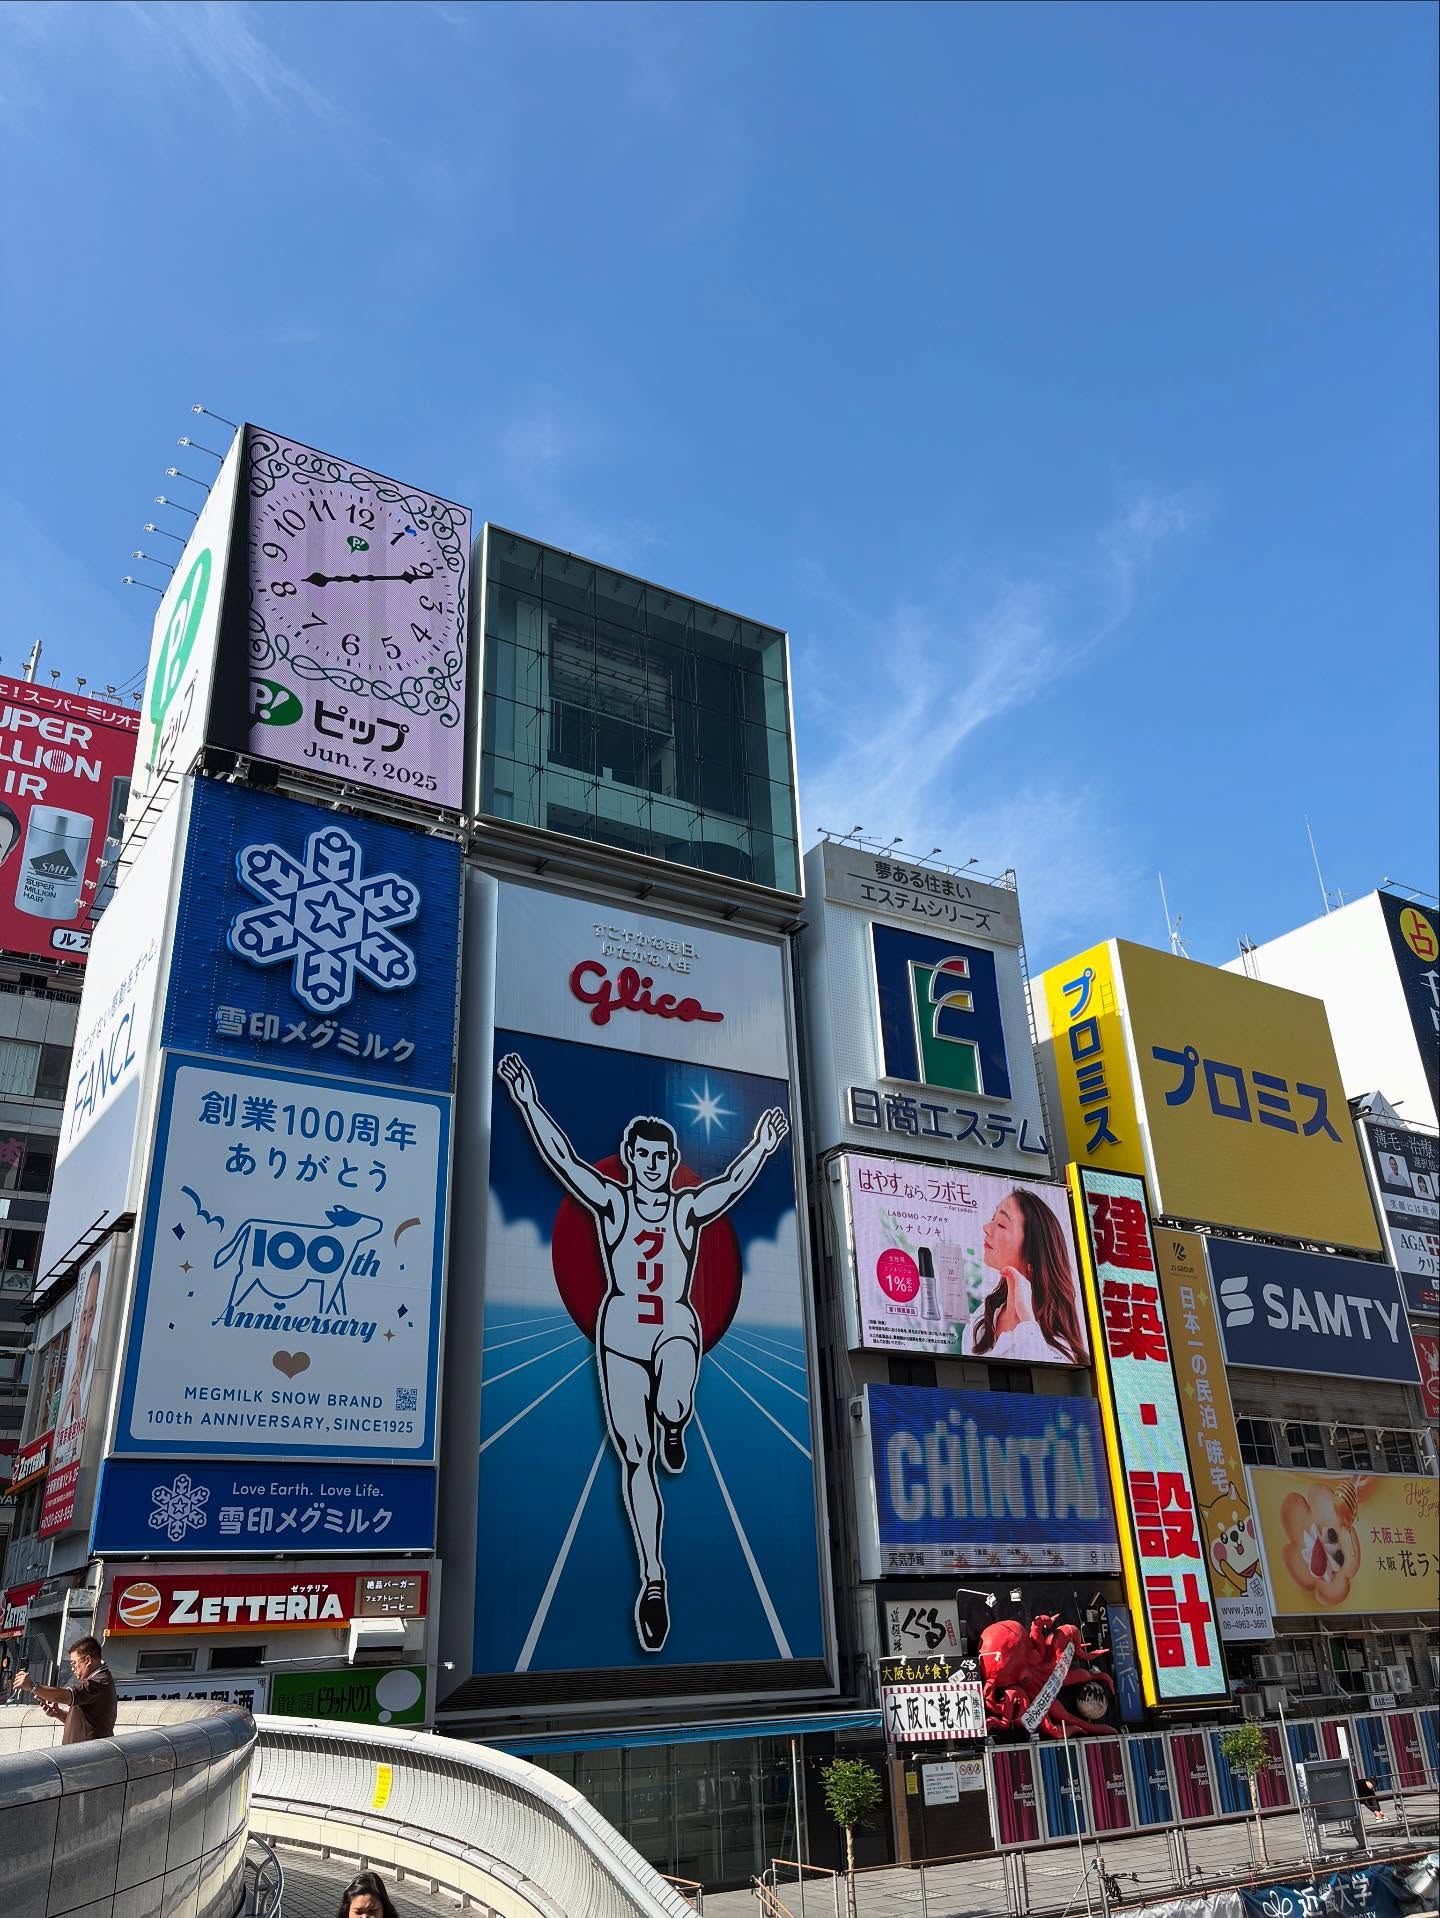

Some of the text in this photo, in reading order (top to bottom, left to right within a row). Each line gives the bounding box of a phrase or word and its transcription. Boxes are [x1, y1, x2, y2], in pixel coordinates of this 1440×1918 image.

[309, 500, 336, 522] 11
[346, 504, 375, 531] 12
[274, 509, 306, 537] 10
[262, 542, 287, 562] 9
[270, 581, 297, 598] 8
[419, 595, 443, 614] 3
[302, 612, 328, 629] 7
[410, 623, 432, 643] 4
[341, 634, 360, 656] 6
[381, 636, 401, 660] 5
[315, 699, 410, 752] ピップ
[304, 742, 357, 769] Jun.
[382, 762, 438, 791] 2025
[42, 862, 69, 875] SMH
[875, 861, 972, 899] 夢ある住まい
[26, 878, 55, 891] SUPER
[23, 891, 44, 903] HAIR
[861, 884, 991, 931] エステムシリーズ
[1408, 910, 1435, 957] 占
[602, 941, 693, 974] ゆたかな人生
[569, 960, 725, 1026] Glico
[217, 1005, 416, 1062] 雪印メグミルク
[70, 1002, 135, 1142] FANCL
[1061, 967, 1122, 1154] プロミス
[1152, 1045, 1344, 1144] プロミス
[198, 1090, 418, 1151] 創業100周年
[848, 1086, 1049, 1156] 日商エステム
[225, 1142, 388, 1192] ありがとう
[887, 1209, 919, 1220] LABOMO
[1400, 1234, 1428, 1252] AGA
[633, 1226, 667, 1325] グリコ
[211, 1305, 378, 1343] Anniversary
[1262, 1283, 1399, 1344] SAMTY
[184, 1387, 383, 1409] MEGMILK SNOW BRAND
[147, 1410, 193, 1425] 100th
[232, 1482, 384, 1497] Love Earth. Love Life.
[218, 1502, 393, 1534] 雪印メグミルク
[1370, 1527, 1416, 1545] 大阪土産
[889, 1552, 925, 1568] 天気予報
[1377, 1557, 1396, 1571] 大阪
[291, 1584, 329, 1593] ゼッテリア
[366, 1579, 416, 1590] 絶品バーガー
[169, 1590, 344, 1624] ZETTERIA
[381, 1603, 414, 1611] コーヒー
[1221, 1604, 1264, 1617] www.jsv.jp
[901, 1607, 947, 1649] くくる
[882, 1663, 952, 1682] 大阪もんを食す
[966, 1672, 978, 1681] 2F
[889, 1692, 970, 1732] 大阪に乾杯
